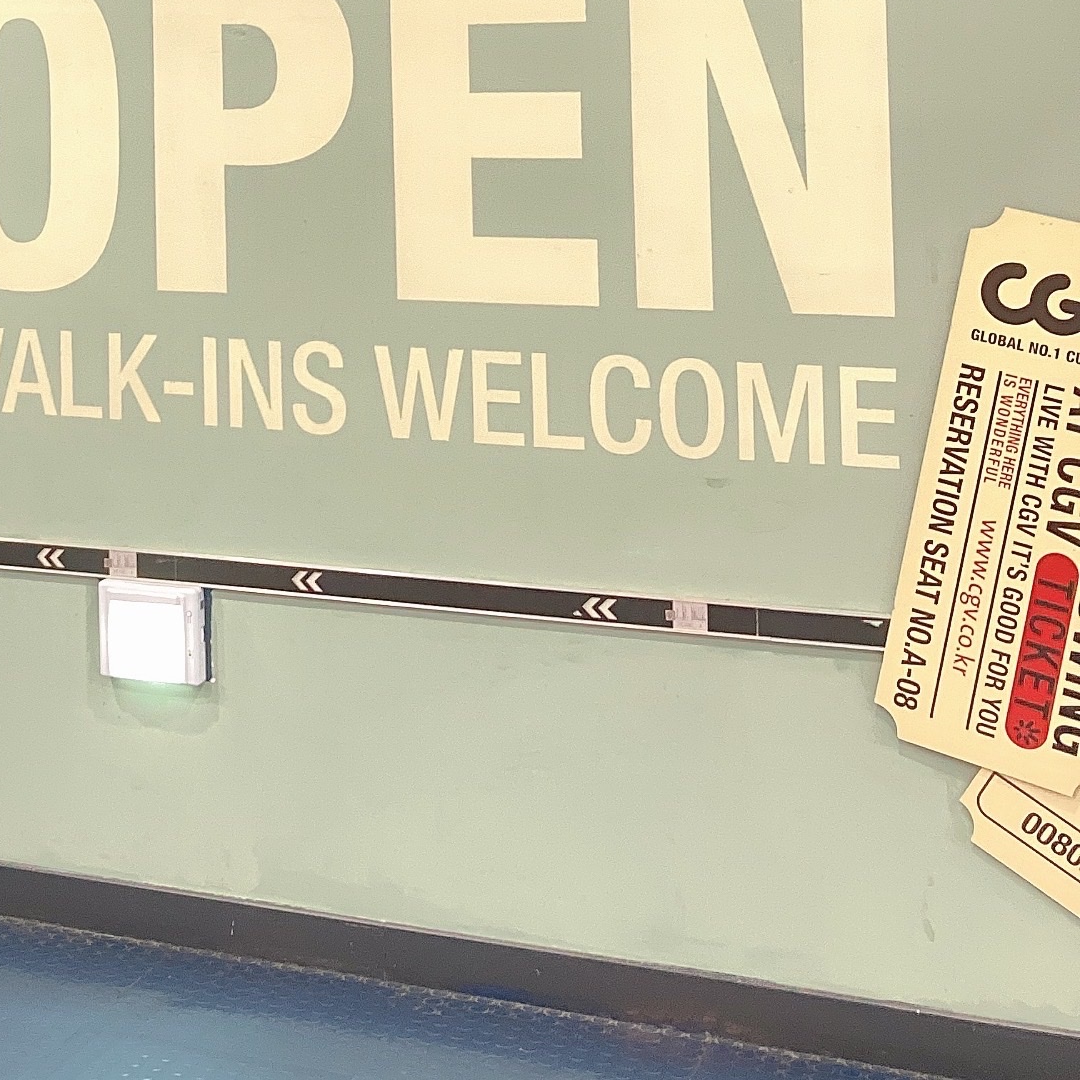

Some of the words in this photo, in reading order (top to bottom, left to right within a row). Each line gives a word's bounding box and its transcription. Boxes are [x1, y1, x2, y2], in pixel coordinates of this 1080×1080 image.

[971, 328, 1024, 351] GLOBAL
[1028, 341, 1060, 360] NO.1
[373, 344, 901, 470] WELCOME
[1003, 373, 1018, 389] IS
[1037, 383, 1065, 430] LIVE
[984, 395, 1014, 483] WONDERFUL
[1005, 377, 1032, 454] EVERYTHING
[928, 363, 986, 535] RESERVATION
[998, 456, 1016, 490] HERE
[1025, 436, 1055, 489] WITH
[1017, 494, 1042, 537] CGV
[915, 539, 949, 605] SEAT
[1007, 541, 1033, 582] IT'S
[953, 520, 997, 676] www.cgv.co.kr
[995, 587, 1024, 644] GOOD
[984, 649, 1011, 691] FOR
[1014, 578, 1076, 720] TICKET
[975, 698, 1002, 738] YOU
